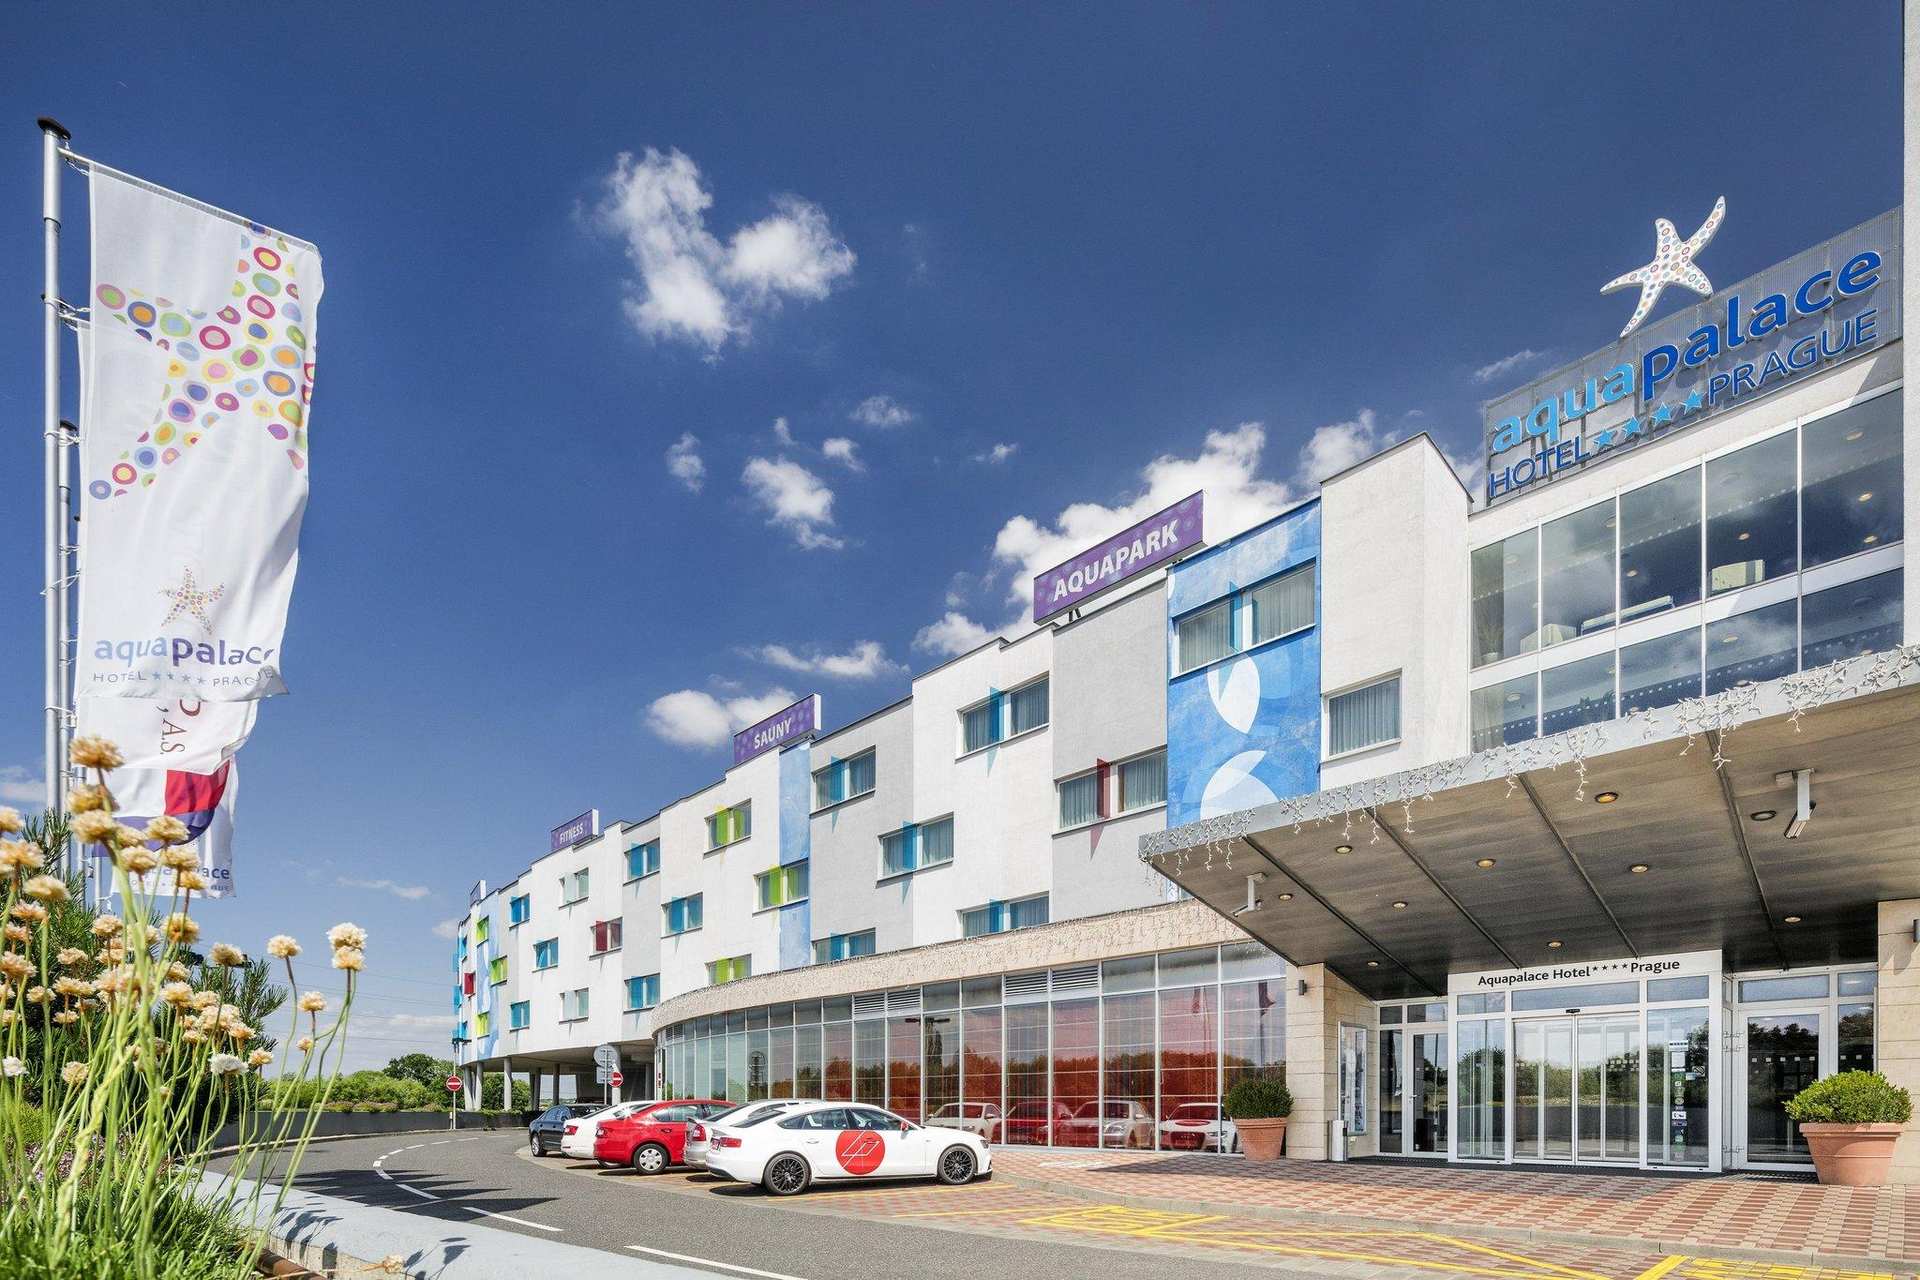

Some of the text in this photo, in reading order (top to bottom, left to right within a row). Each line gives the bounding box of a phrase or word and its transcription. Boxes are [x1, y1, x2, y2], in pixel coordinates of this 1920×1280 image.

[1487, 307, 1879, 498] HOTEL PRAGUE
[1053, 518, 1179, 602] AQUAPARK
[93, 671, 147, 684] HOTEL
[754, 717, 792, 749] SAUNY
[560, 822, 584, 844] FITNESS
[1477, 960, 1680, 987] Aquapalace Hotel Prague
